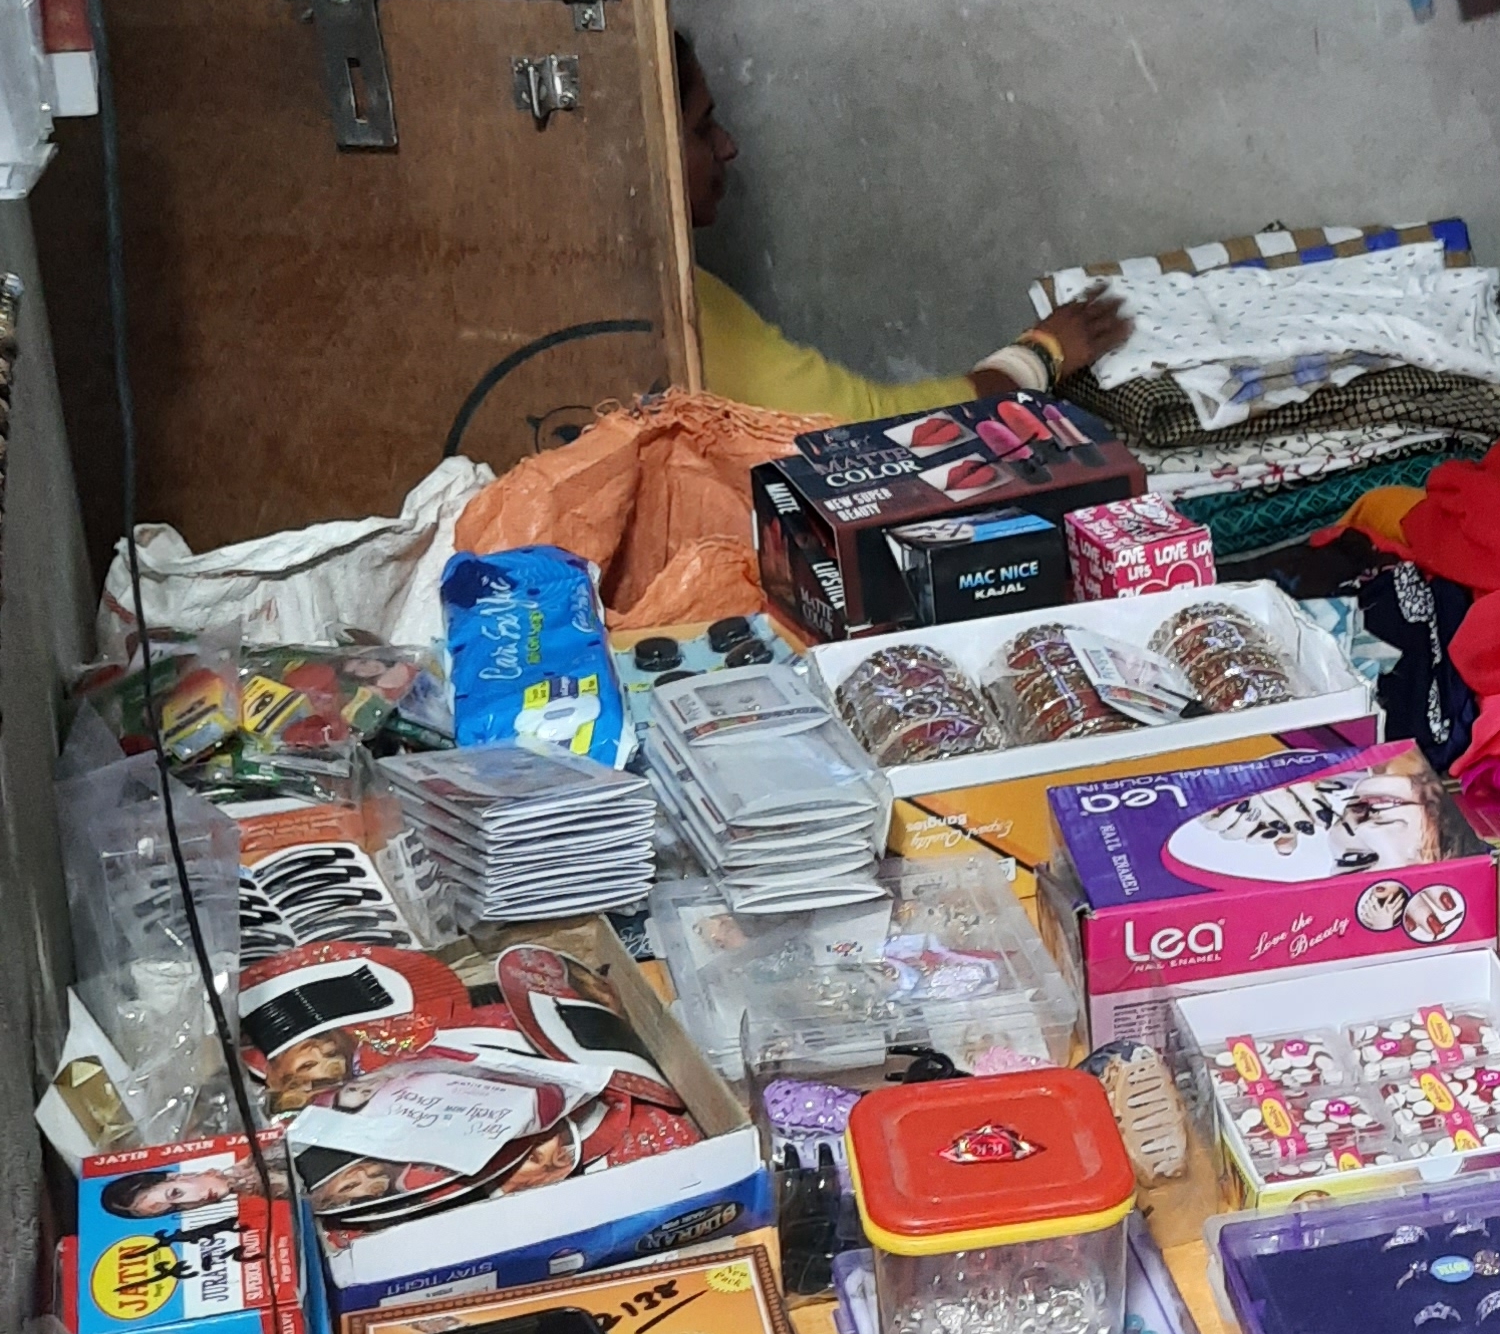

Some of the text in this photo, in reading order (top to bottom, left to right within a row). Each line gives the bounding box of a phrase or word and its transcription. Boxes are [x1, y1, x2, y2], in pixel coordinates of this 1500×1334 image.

[820, 447, 913, 476] MATTE
[826, 459, 922, 488] COLOR
[765, 482, 801, 515] MATTE
[853, 487, 893, 505] SUPER
[837, 502, 881, 522] BEAUTY
[1154, 540, 1188, 566] LOVE
[958, 560, 1040, 590] MAC NICE
[974, 582, 1026, 601] KAJAL
[1080, 785, 1188, 816] Lea
[906, 813, 967, 834] Bangles
[1123, 919, 1224, 964] Lea
[94, 1150, 149, 1166] JATIN
[160, 1139, 216, 1157] JATIN
[118, 1243, 149, 1313] JATIN
